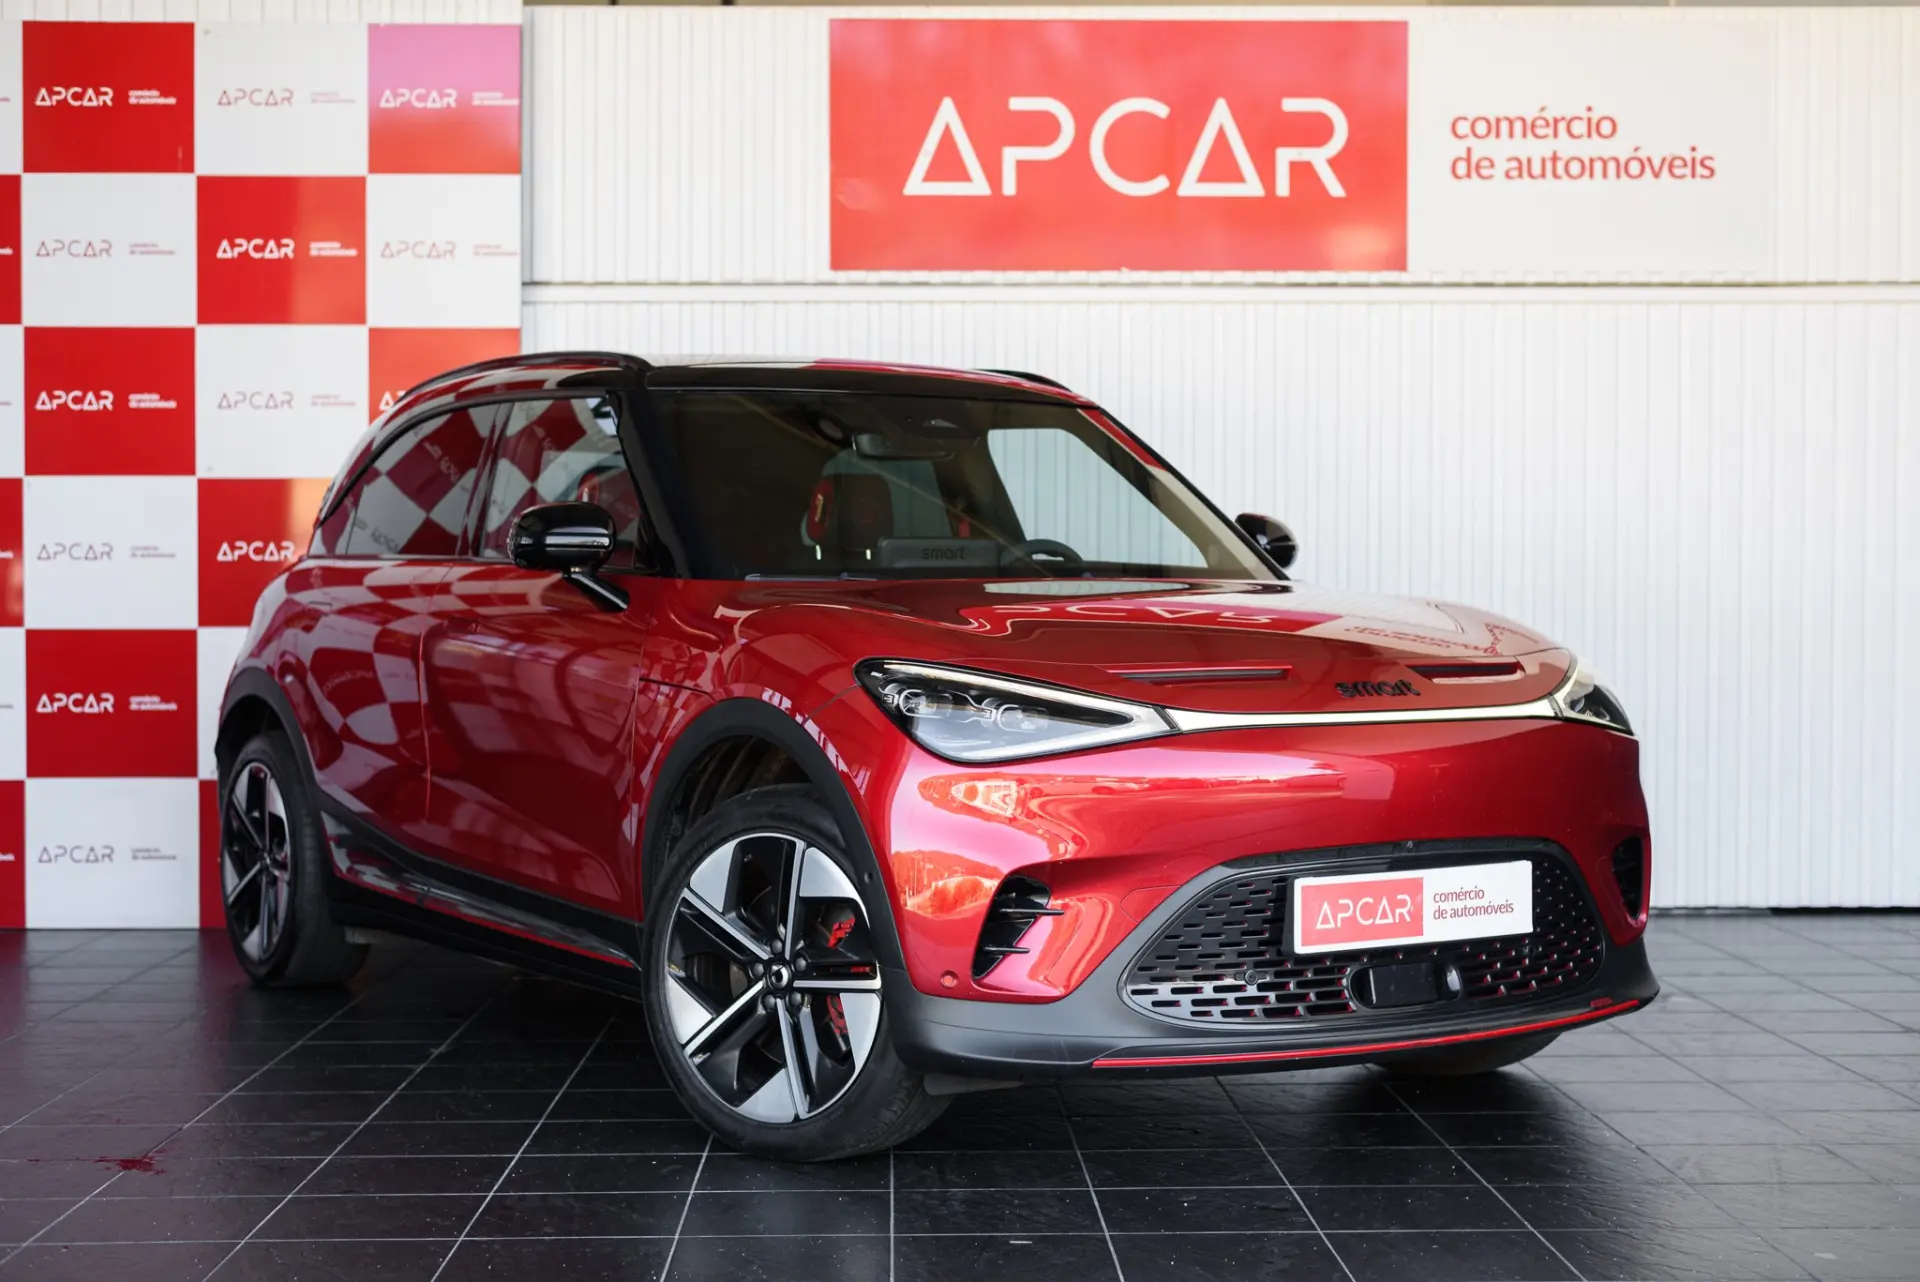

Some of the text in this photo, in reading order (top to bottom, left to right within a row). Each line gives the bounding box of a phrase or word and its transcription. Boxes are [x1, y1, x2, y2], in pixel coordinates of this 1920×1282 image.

[35, 87, 113, 107] APCAR
[217, 88, 294, 107] APCAR
[379, 89, 457, 108] APCAR
[1450, 105, 1618, 140] comércio
[902, 96, 1349, 198] APCAR
[1450, 146, 1716, 180] de automóveis
[36, 239, 112, 258] APCAR
[216, 238, 295, 260] APCAR
[380, 241, 457, 259] APCAR
[35, 390, 114, 411] APCAR
[217, 391, 294, 410] APCAR
[36, 543, 114, 561] APCAR
[216, 541, 296, 562] APCAR
[921, 547, 965, 560] smart
[1335, 680, 1421, 698] smart
[36, 693, 115, 713] APCAR
[38, 845, 115, 864] APCAR
[1433, 886, 1485, 903] comércio
[1315, 894, 1412, 930] APCAR
[1433, 899, 1514, 920] de automóveis
